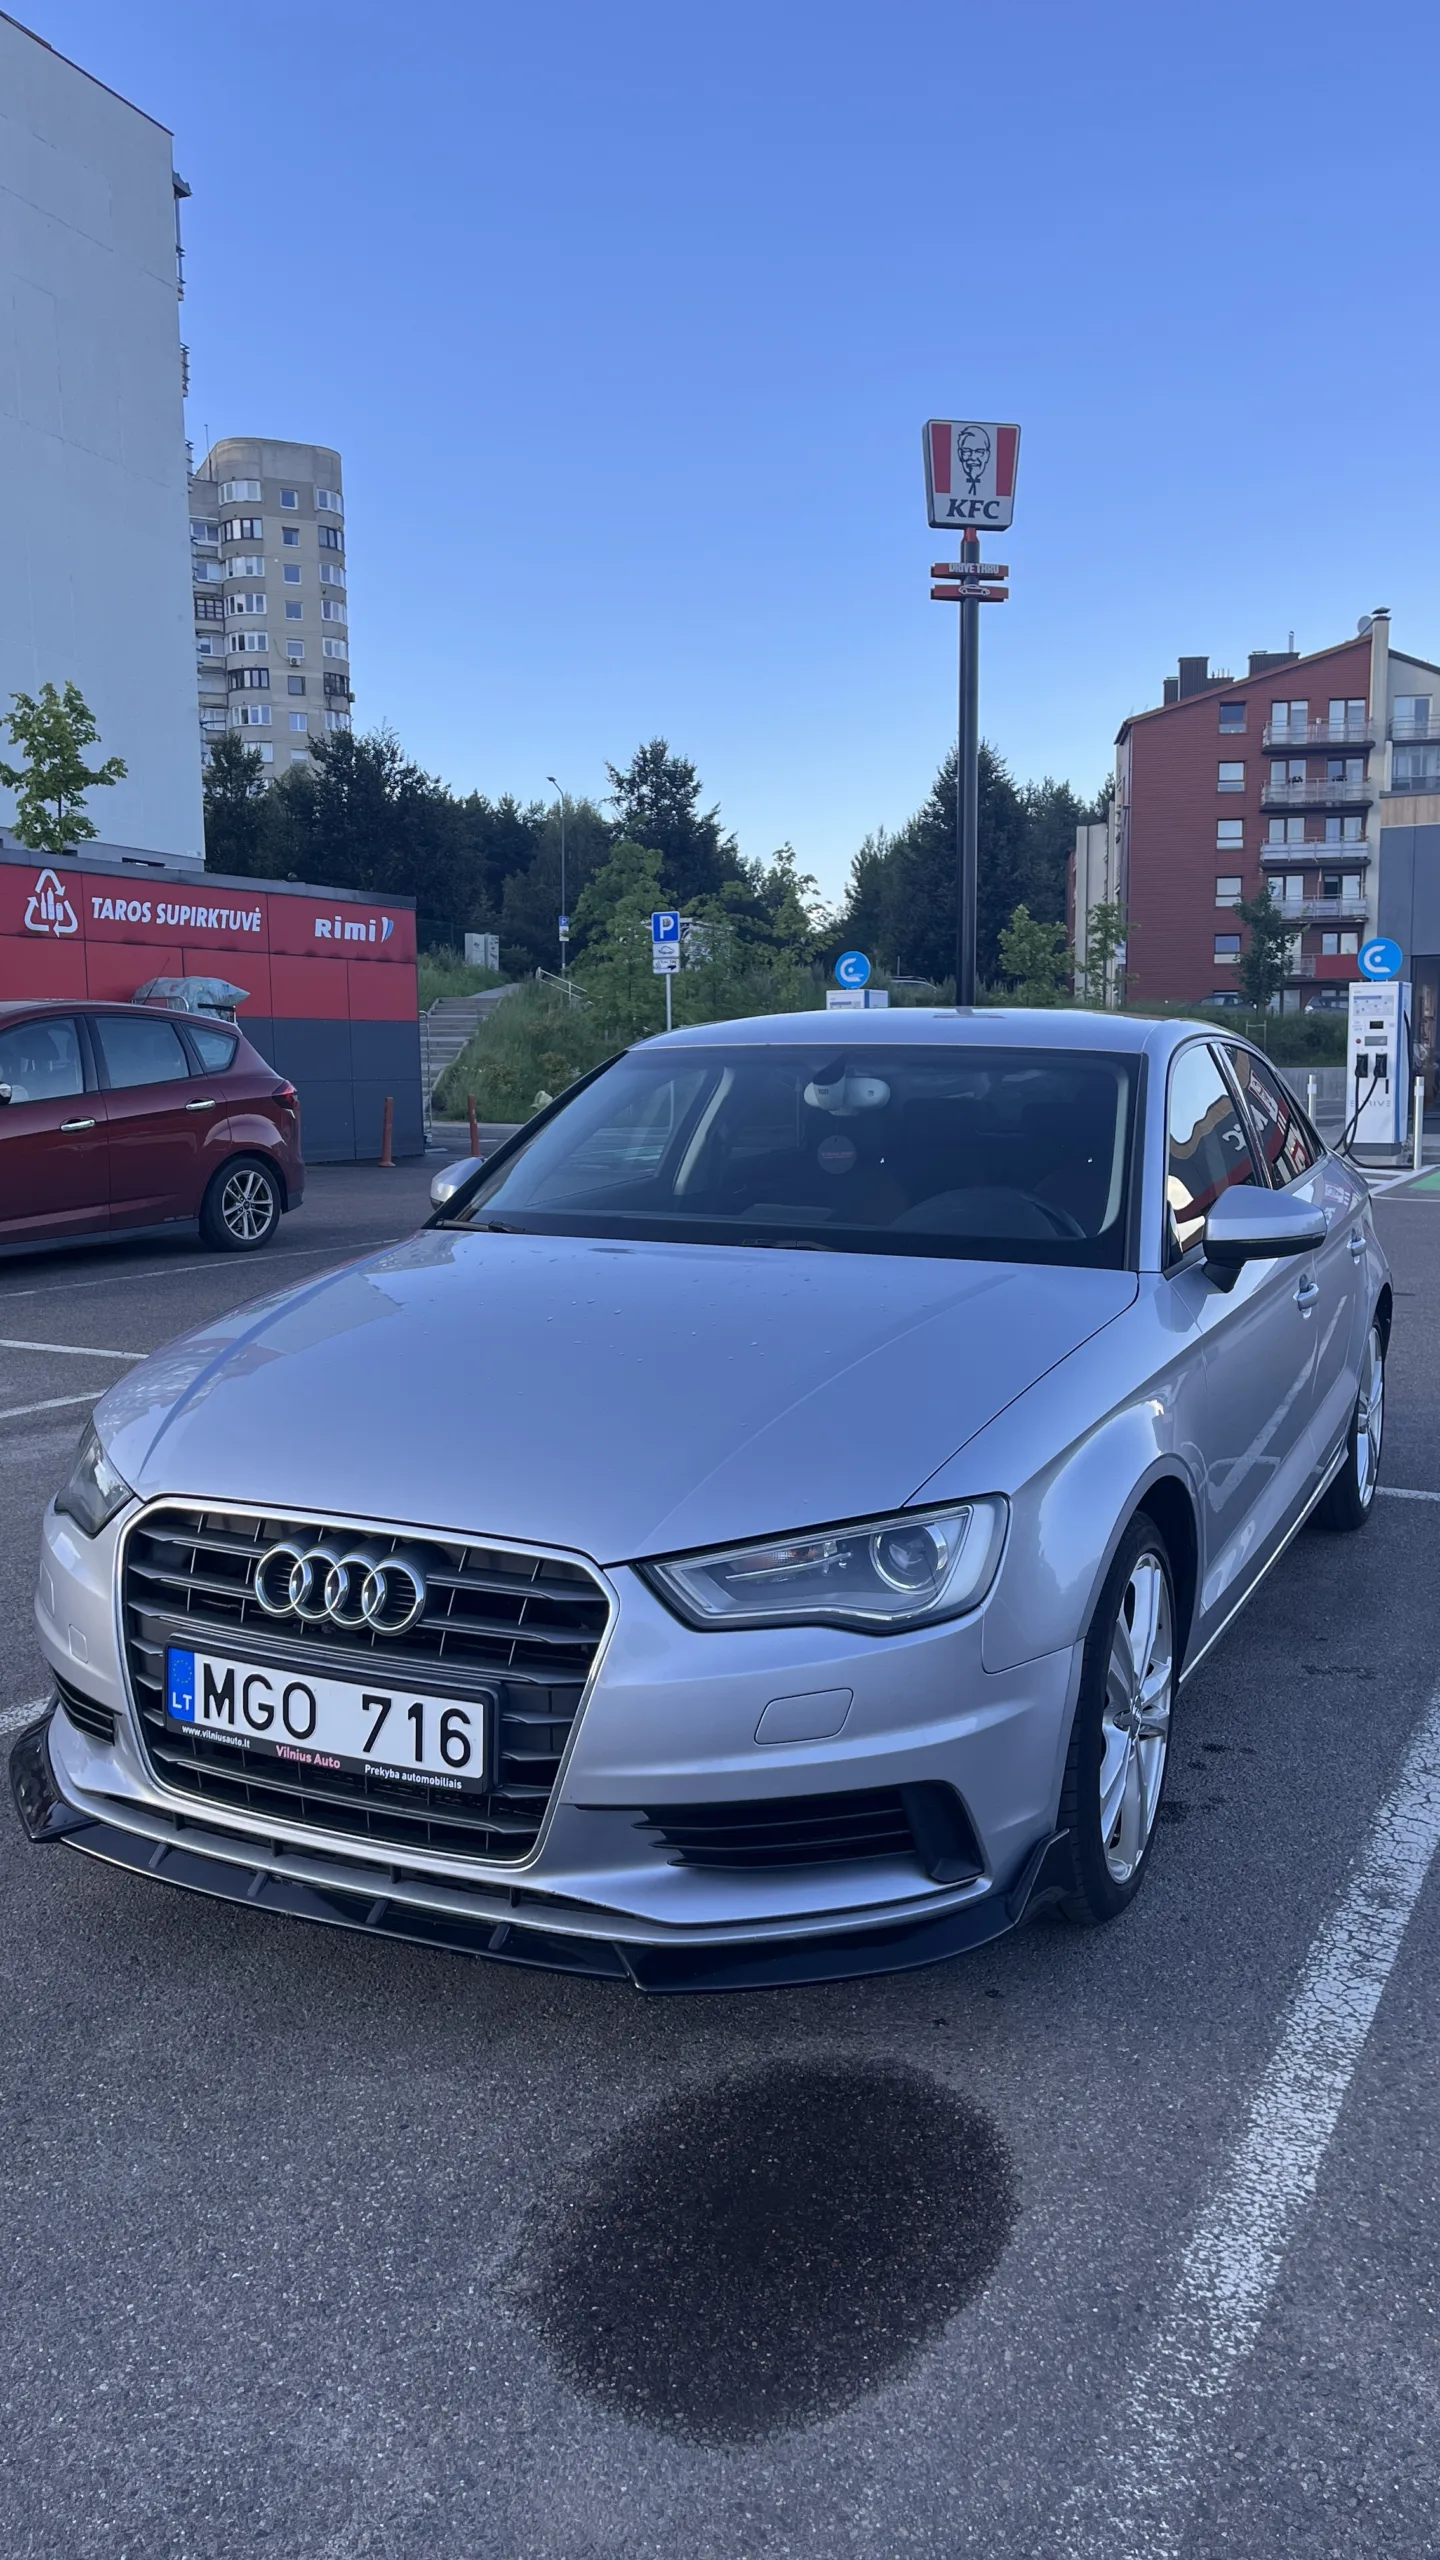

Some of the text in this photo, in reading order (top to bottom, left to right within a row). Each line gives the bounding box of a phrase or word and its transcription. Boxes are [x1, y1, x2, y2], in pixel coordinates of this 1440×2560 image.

[946, 498, 1000, 520] KFC
[948, 563, 1000, 575] DRIVE THRU
[91, 897, 262, 932] TAROS SUPIRKTUVĖ
[314, 915, 377, 942] Rimi
[660, 915, 675, 939] P
[172, 1691, 193, 1711] LT
[203, 1662, 472, 1768] MGO 716
[181, 1725, 251, 1749] www.vilniusauto.lt
[275, 1744, 341, 1769] Vilnius Auto
[364, 1764, 463, 1790] Prekyba automobiliais
